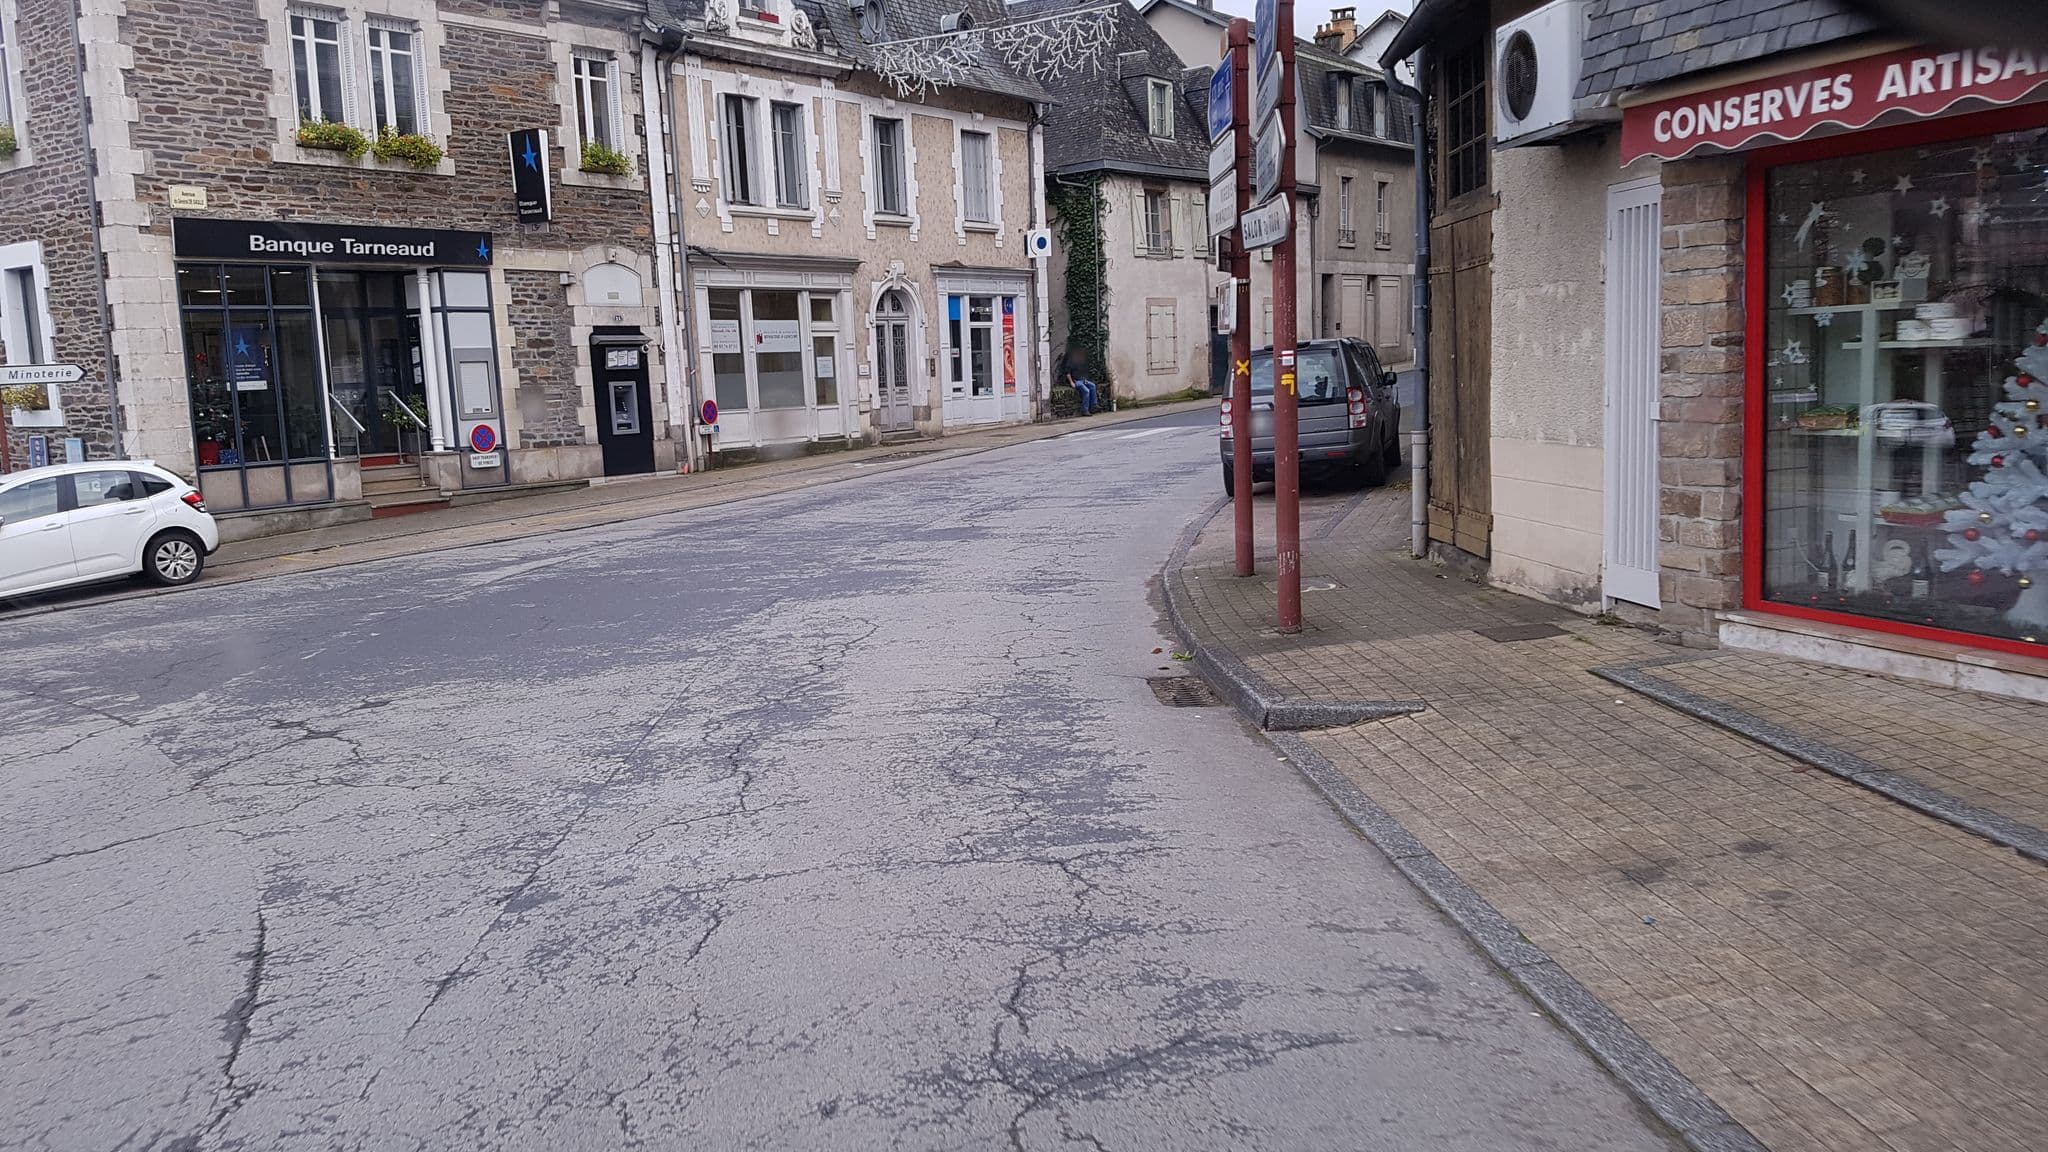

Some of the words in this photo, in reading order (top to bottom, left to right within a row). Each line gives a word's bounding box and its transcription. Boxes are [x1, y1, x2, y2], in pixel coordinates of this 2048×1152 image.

[1654, 73, 1853, 143] CONSERVES
[1876, 45, 2048, 102] ARTISA
[249, 234, 334, 257] Banque
[340, 238, 435, 257] Tarneaud
[8, 368, 72, 380] Minoterie
